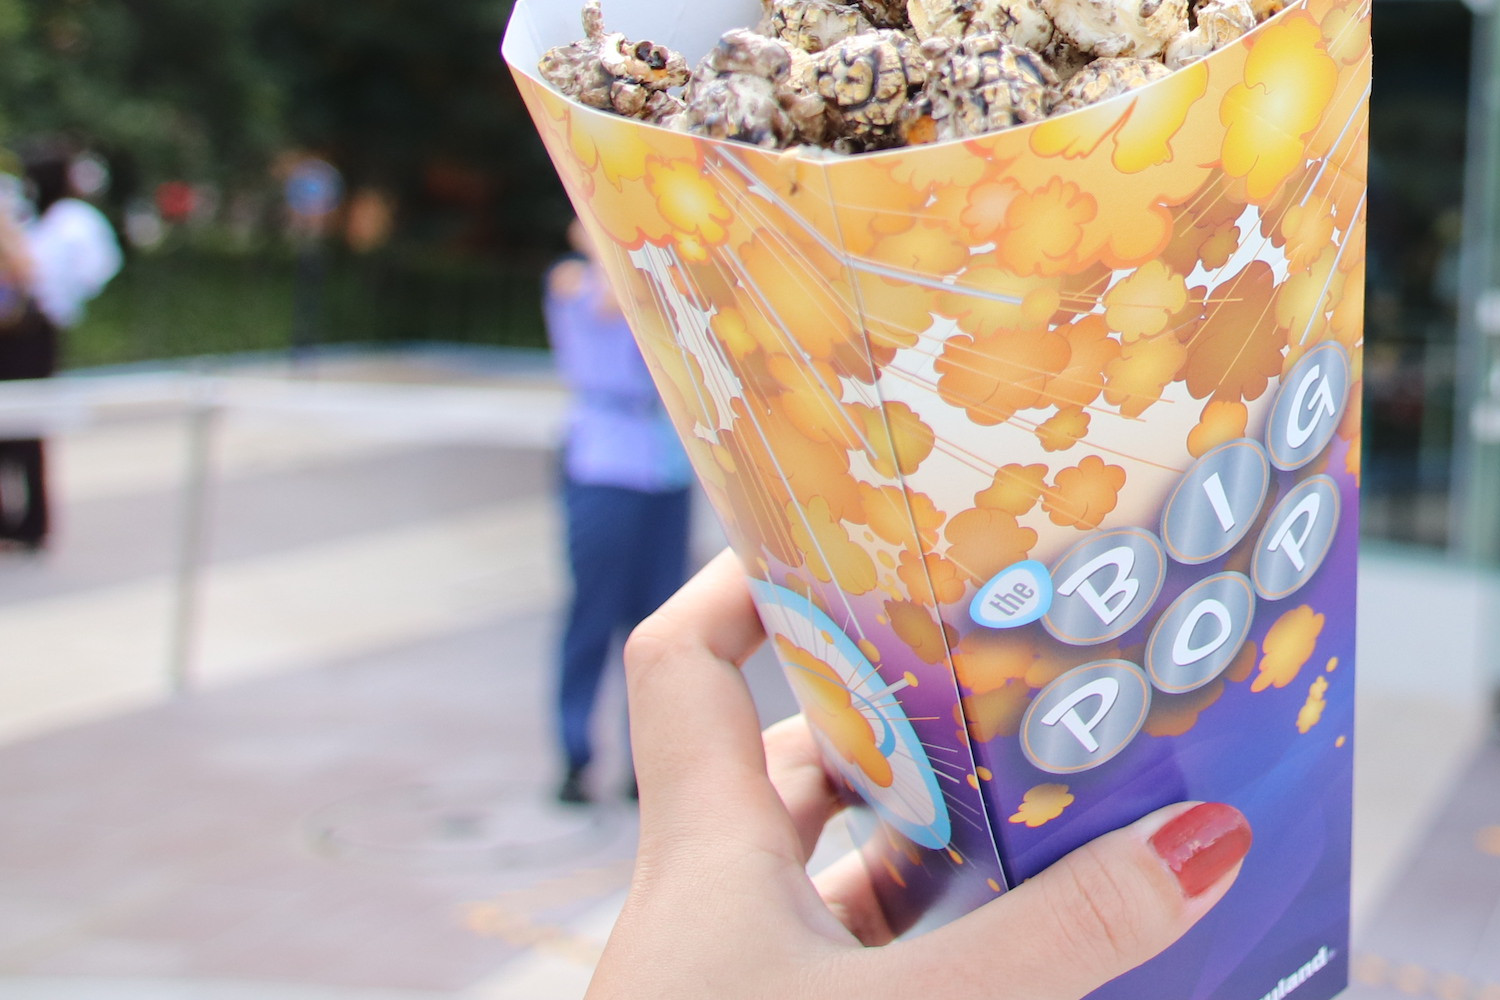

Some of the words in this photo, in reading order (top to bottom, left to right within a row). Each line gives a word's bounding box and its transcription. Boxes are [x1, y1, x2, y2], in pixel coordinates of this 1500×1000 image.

[988, 581, 1036, 618] the
[1056, 363, 1336, 626] BIG
[1040, 491, 1321, 754] POP
